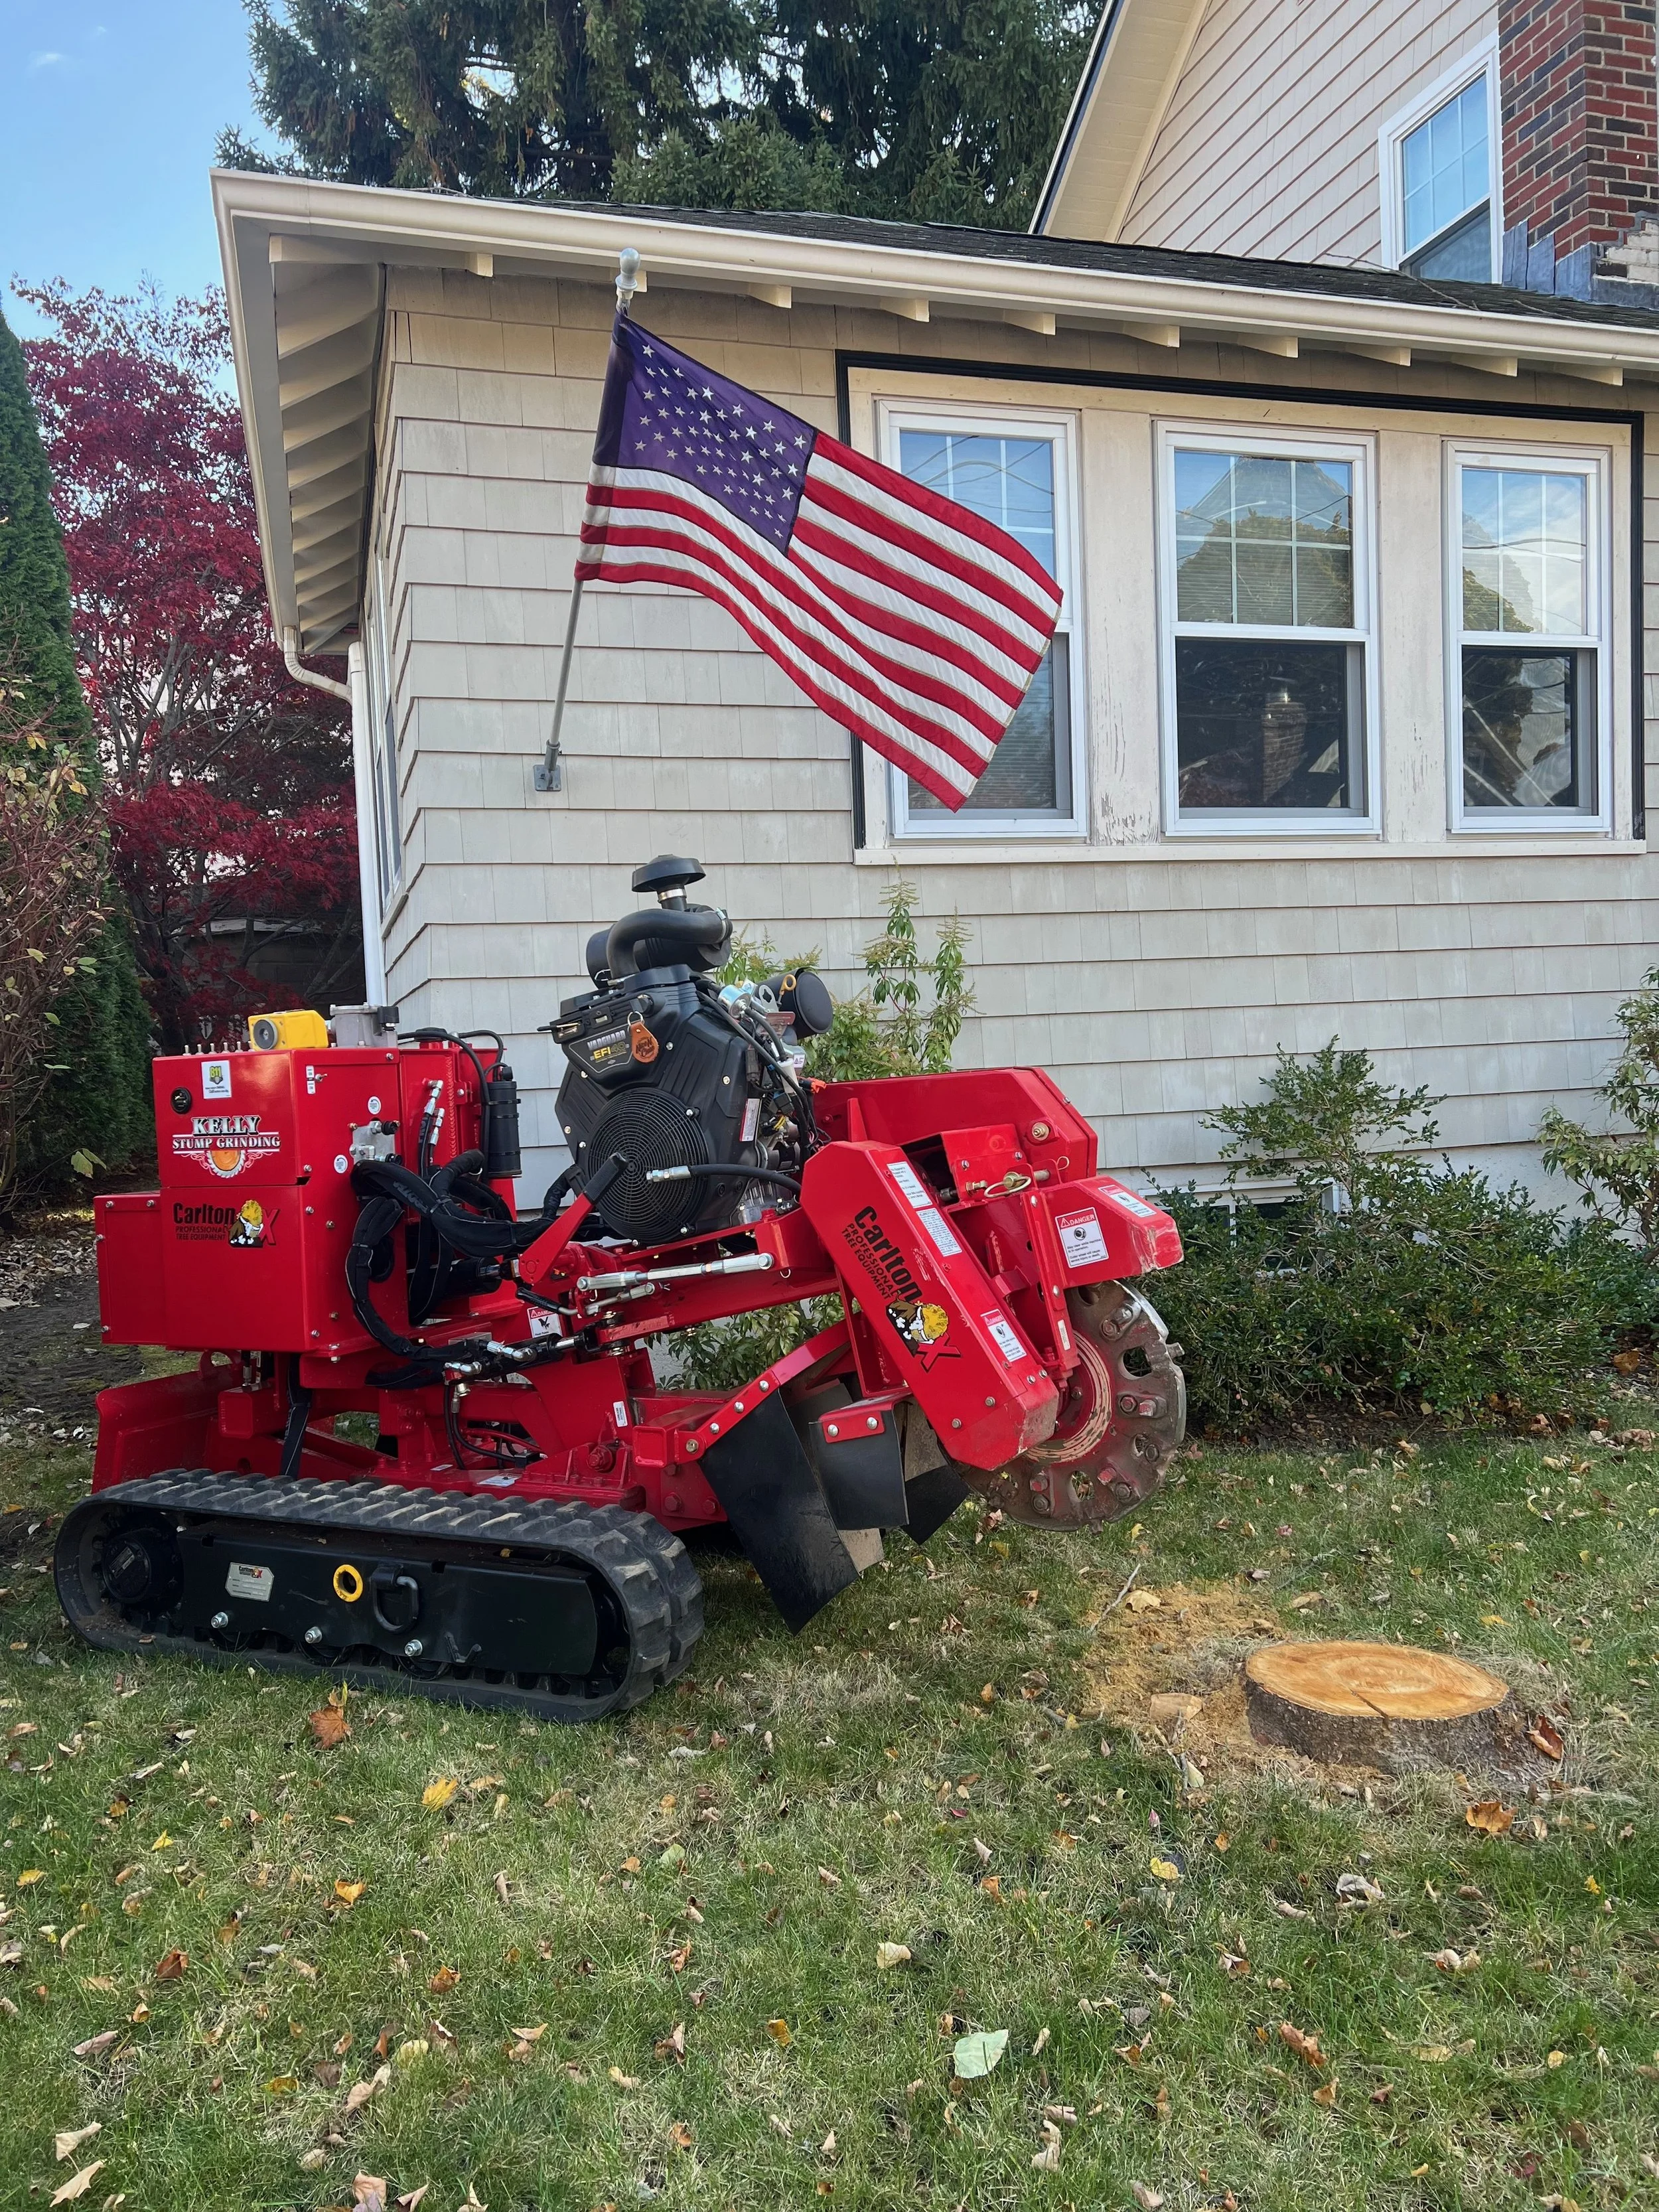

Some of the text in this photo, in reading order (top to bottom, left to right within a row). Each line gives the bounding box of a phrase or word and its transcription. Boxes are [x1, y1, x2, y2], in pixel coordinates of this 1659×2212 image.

[587, 1030, 626, 1050] VANGUARD
[593, 1047, 611, 1059] EFI
[191, 1115, 261, 1137] KELLY
[173, 1136, 281, 1149] STUMP GRINDING
[173, 1202, 236, 1225] Carlton
[1070, 1215, 1095, 1226] DANGER
[841, 1228, 891, 1299] TREE EQUIPMENT
[847, 1223, 899, 1297] PROFESSIONAL
[855, 1206, 923, 1302] Carlton
